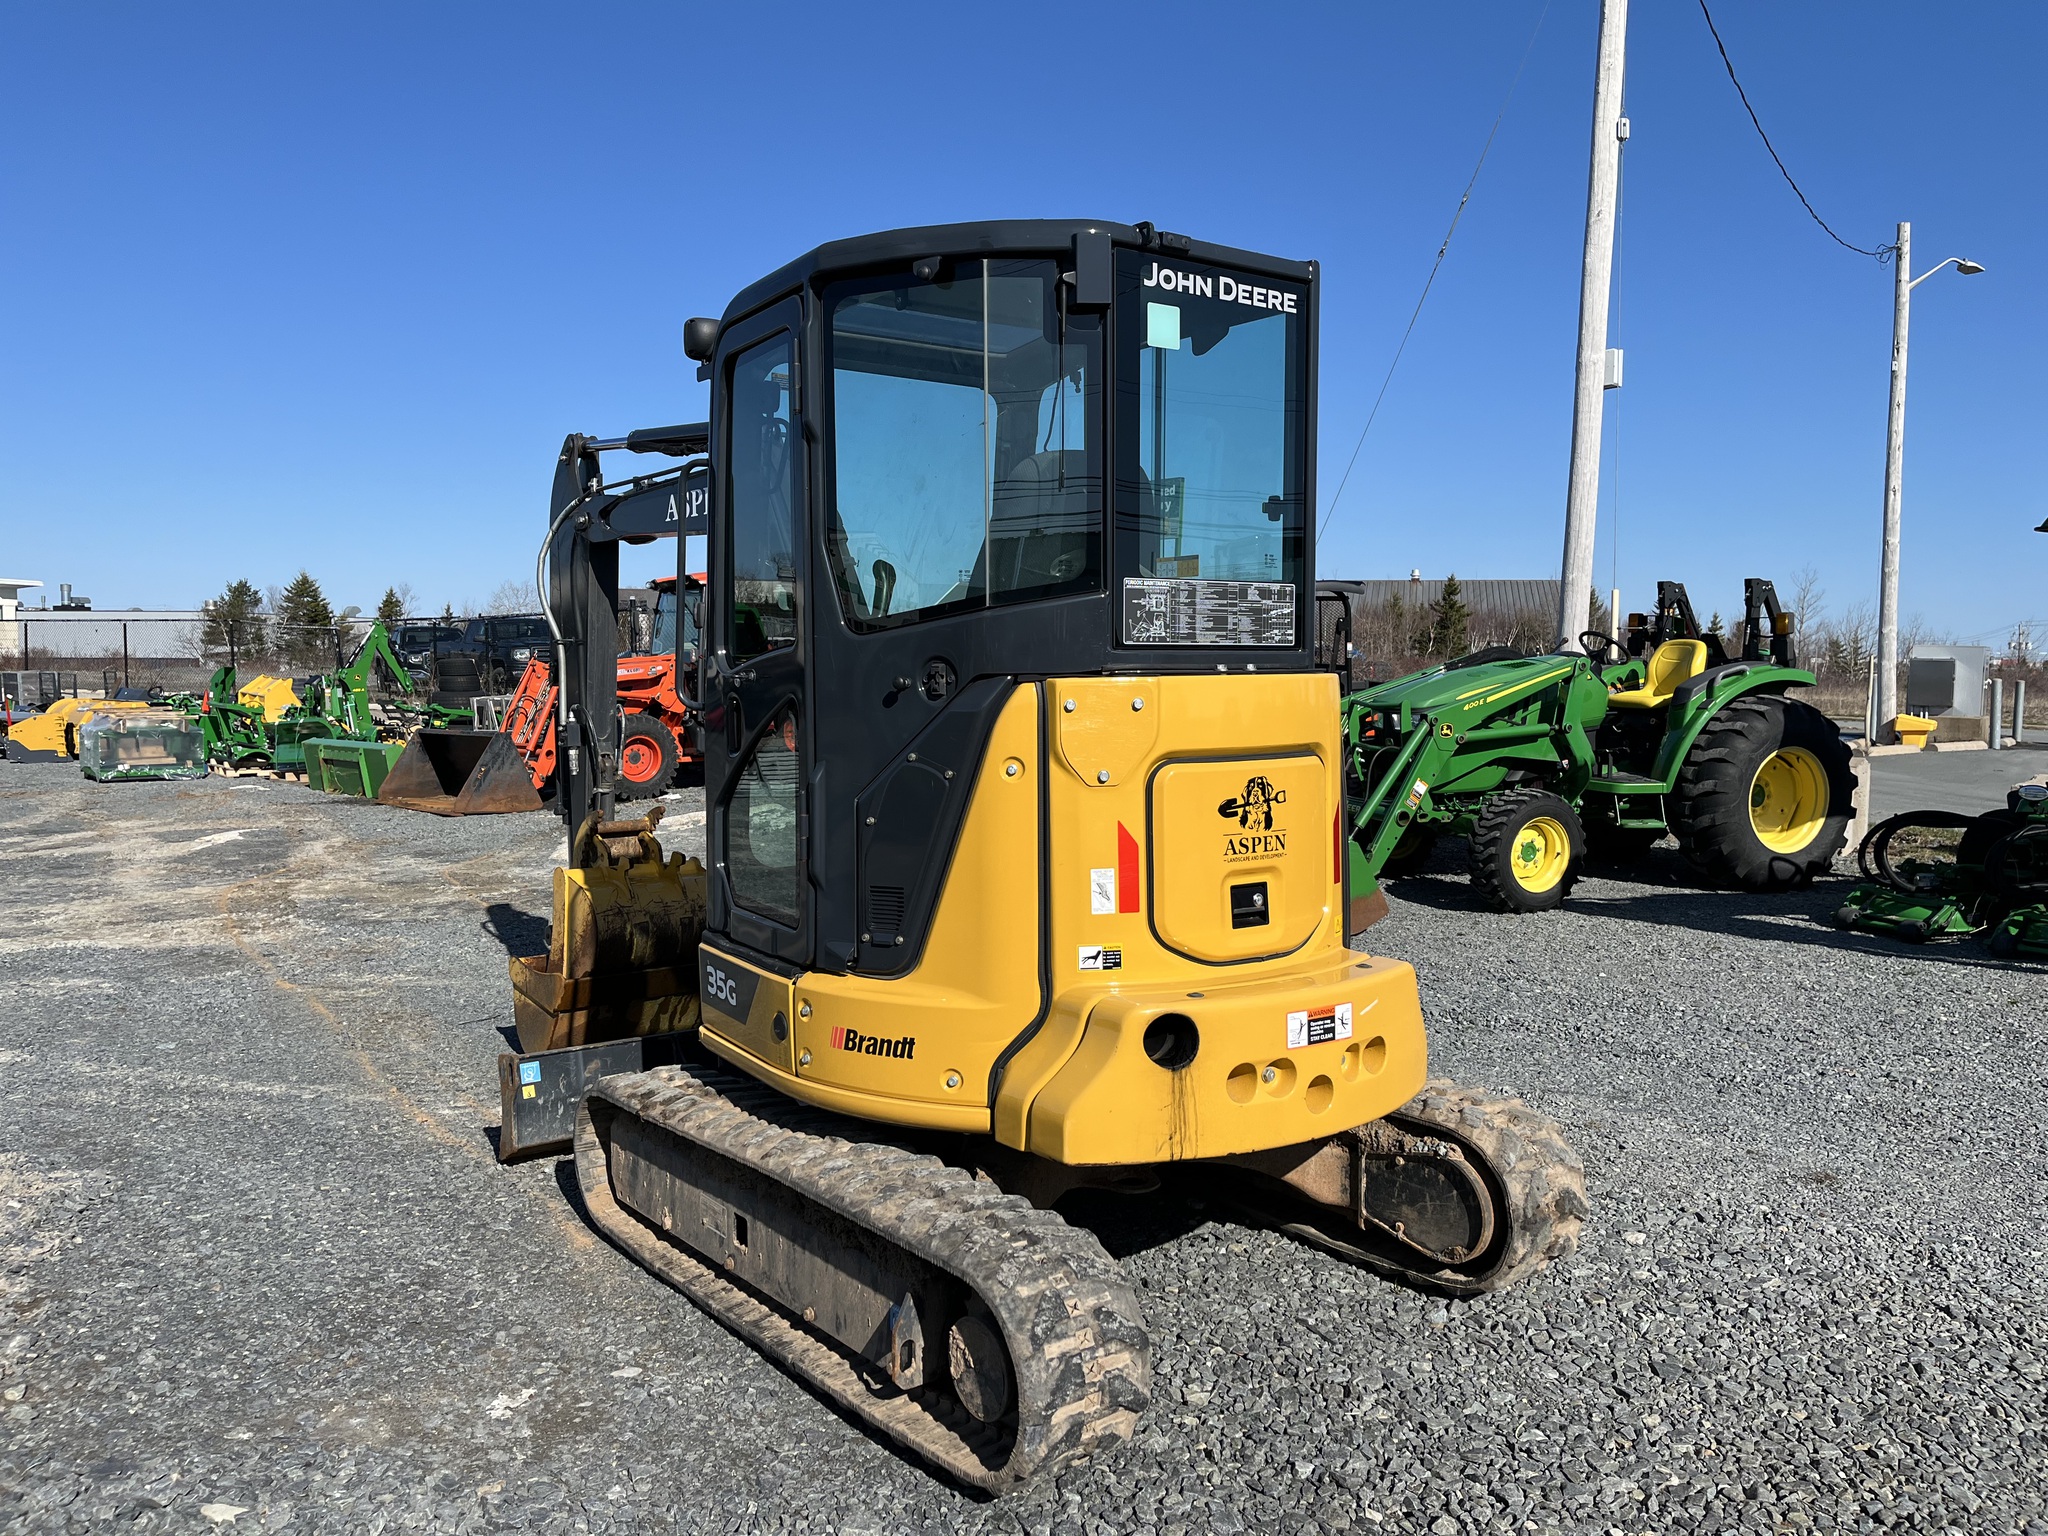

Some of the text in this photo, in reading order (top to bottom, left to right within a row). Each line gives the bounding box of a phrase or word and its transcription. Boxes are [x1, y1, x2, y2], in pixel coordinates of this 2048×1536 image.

[1143, 262, 1297, 314] JOHN DEERE
[1223, 834, 1286, 856] ASPEN
[1260, 852, 1284, 860] DEVELOPMENT
[706, 965, 737, 1007] 35G
[1313, 1008, 1335, 1016] WARNING
[843, 1028, 916, 1060] Brandt
